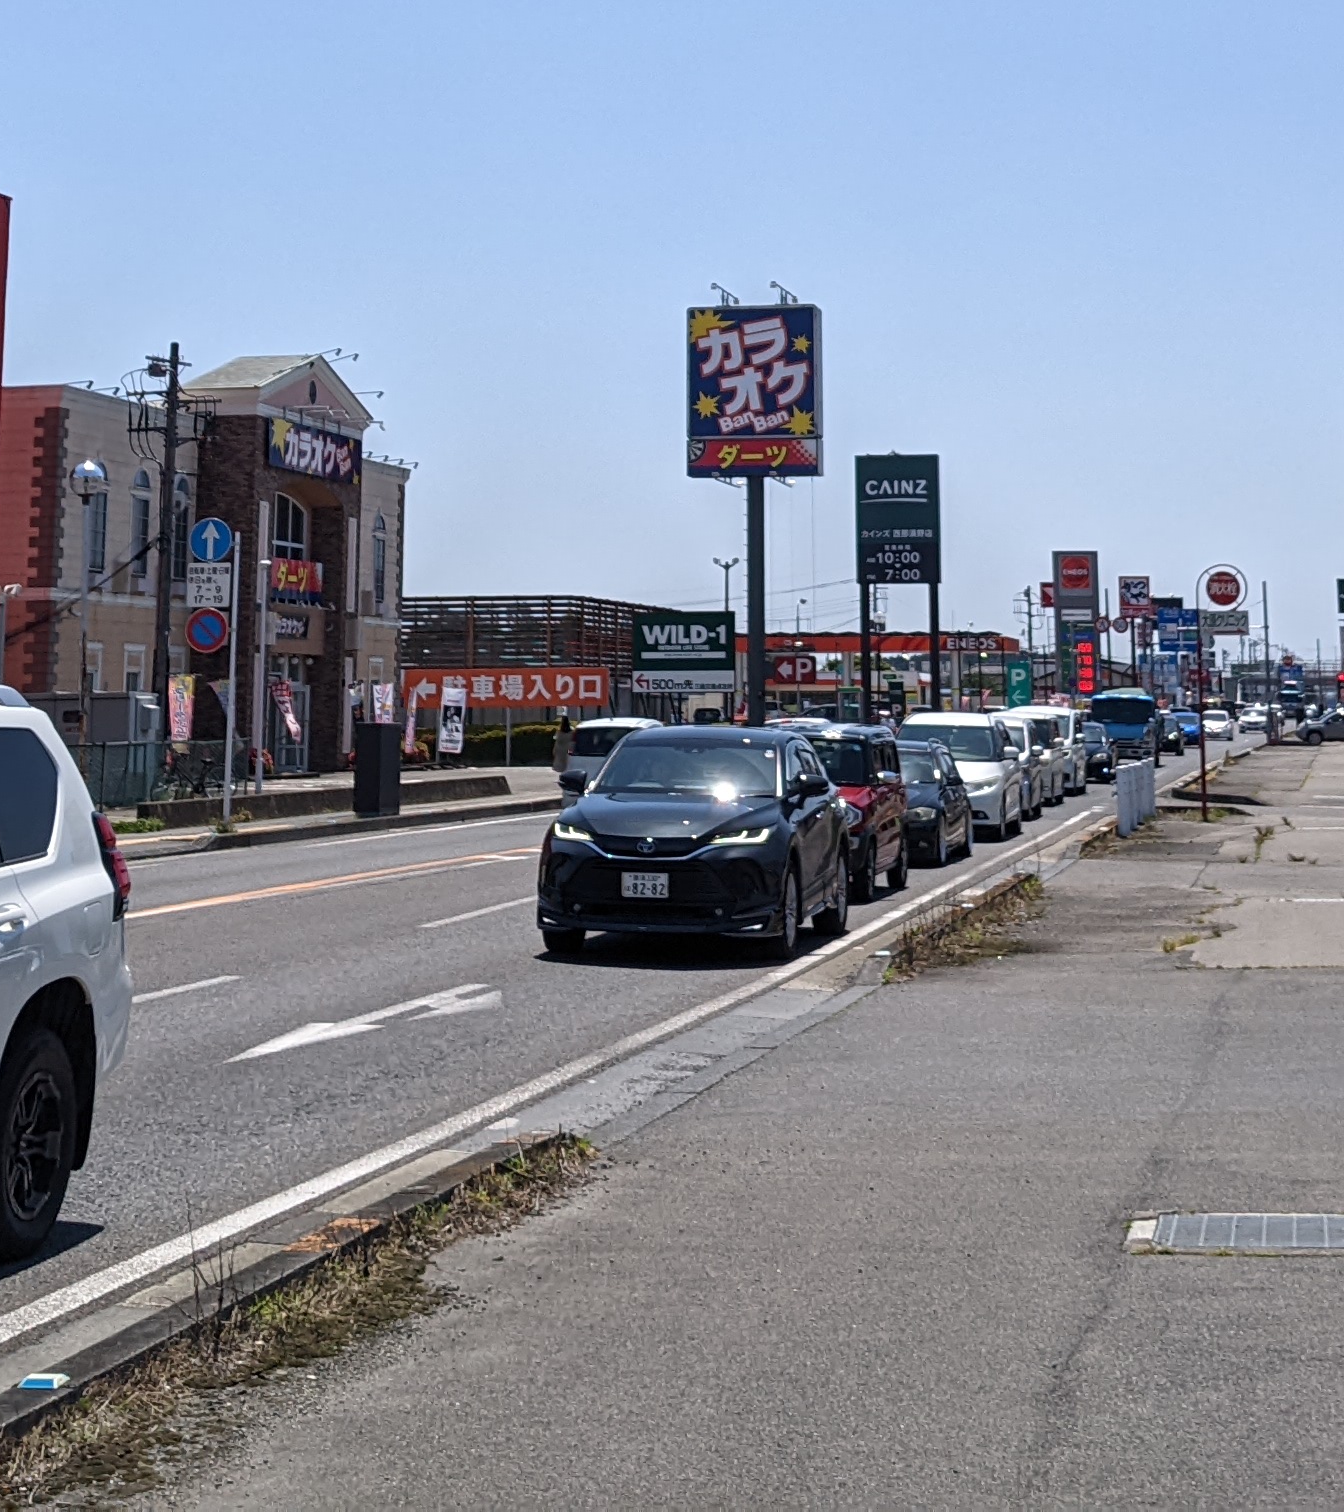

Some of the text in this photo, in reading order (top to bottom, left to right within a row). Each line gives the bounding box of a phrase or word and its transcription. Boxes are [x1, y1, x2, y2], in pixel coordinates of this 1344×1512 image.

[697, 316, 788, 378] カラ
[720, 359, 810, 416] オケ
[284, 428, 336, 476] カラオケ
[717, 444, 788, 470] ダーツ
[865, 479, 928, 495] CAINZ
[876, 551, 921, 564] 10:00
[277, 560, 307, 593] ダーツ
[885, 568, 921, 581] 7:00
[641, 624, 727, 645] WILD-1
[946, 637, 998, 650] ENEOS
[796, 658, 813, 682] P
[1010, 668, 1027, 686] P
